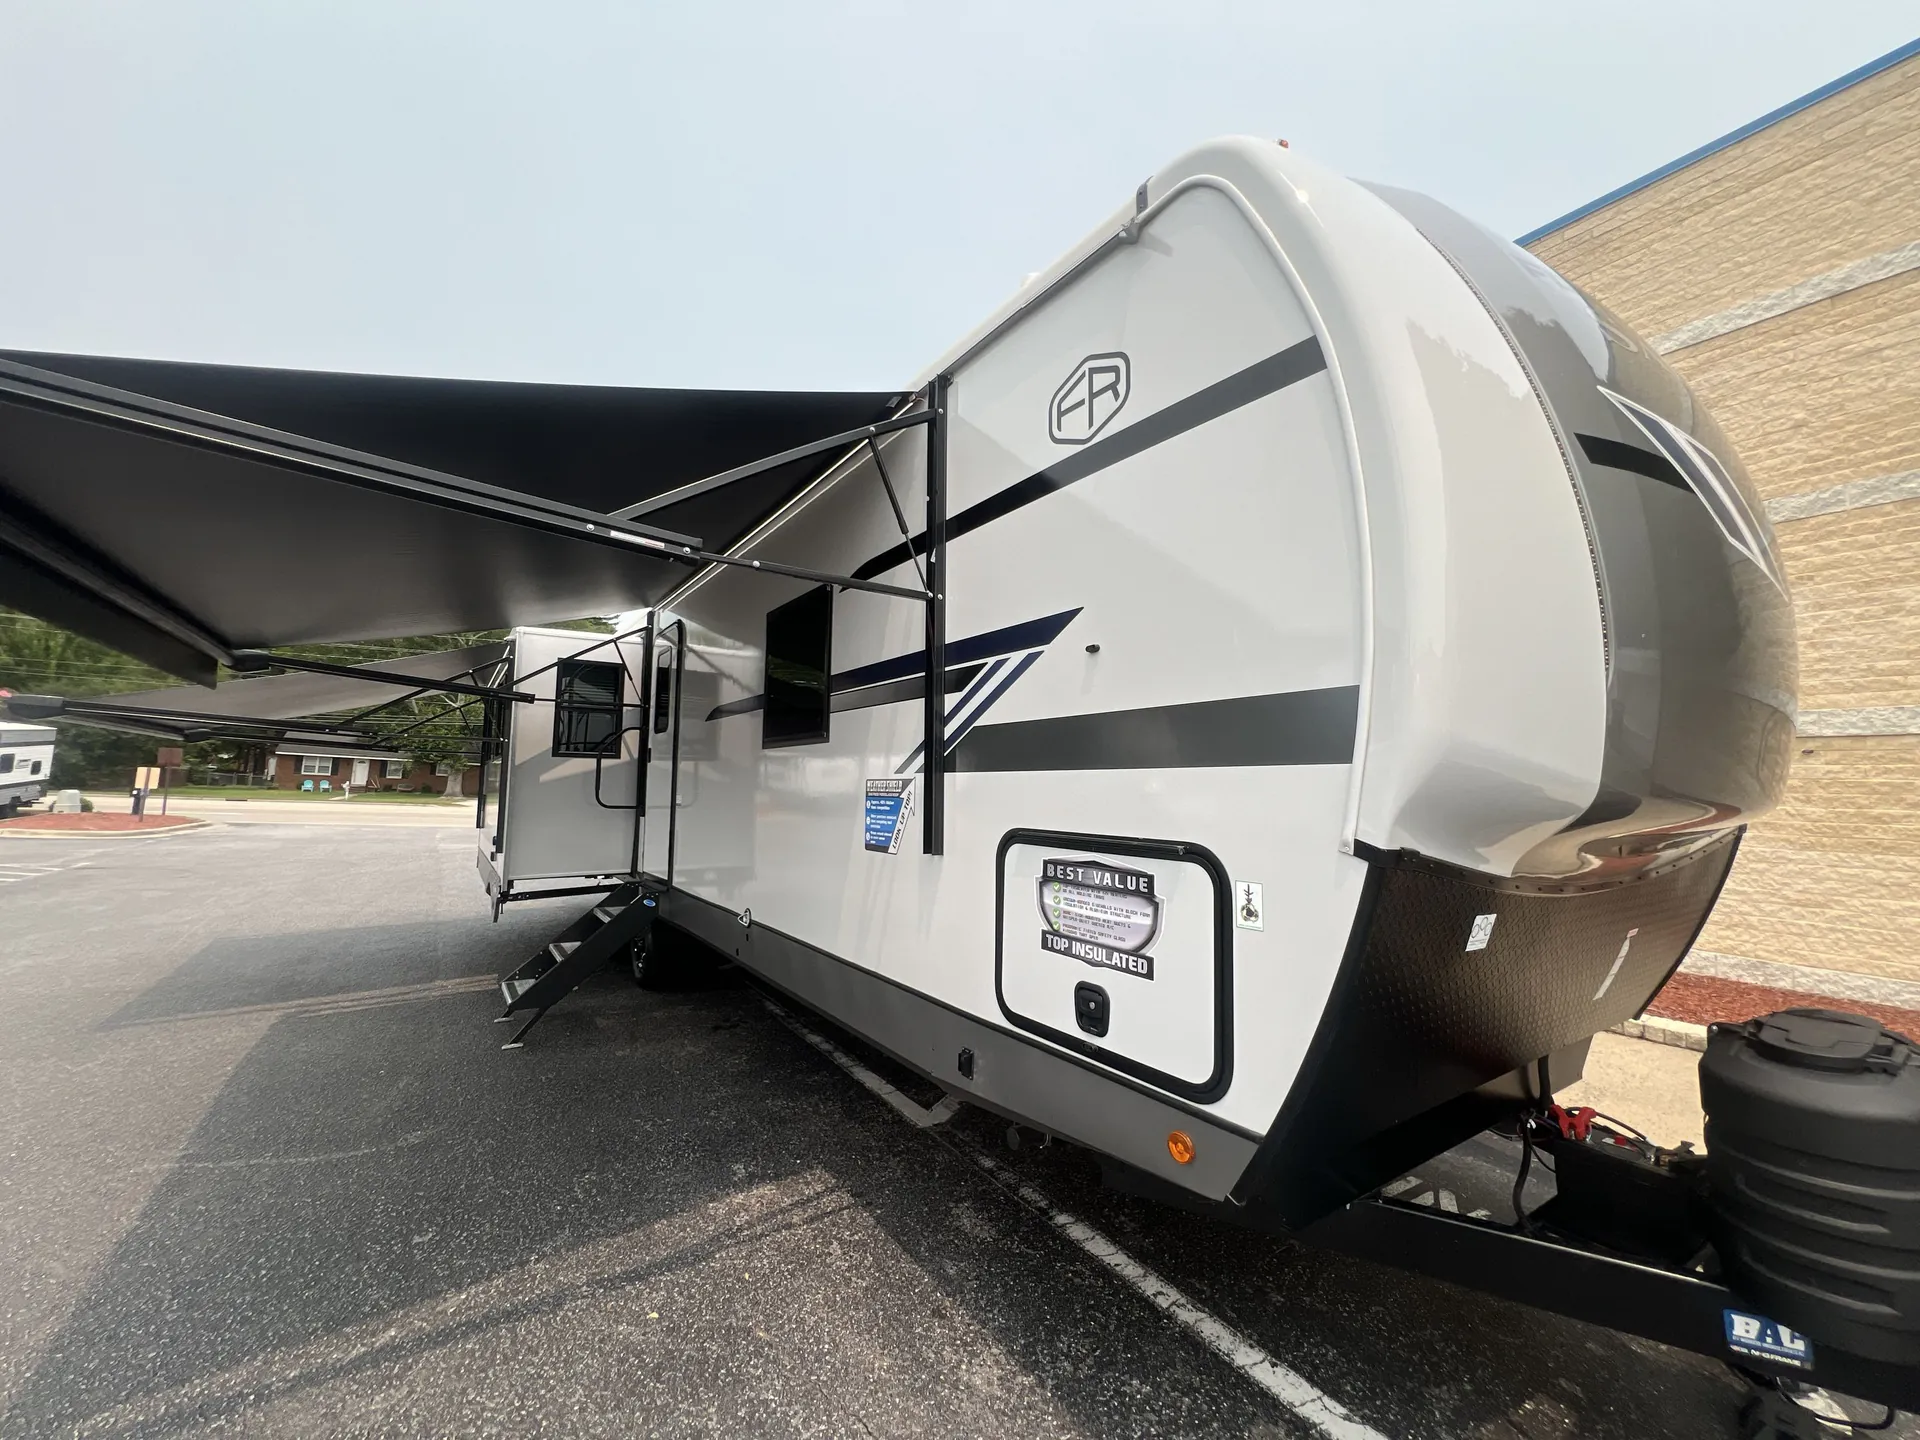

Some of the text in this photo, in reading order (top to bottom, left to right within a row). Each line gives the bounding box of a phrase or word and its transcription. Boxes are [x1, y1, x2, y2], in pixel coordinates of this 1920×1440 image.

[1046, 863, 1085, 882] BEST
[1093, 870, 1149, 893] VALUE
[1045, 933, 1148, 975] TOP INSULATED
